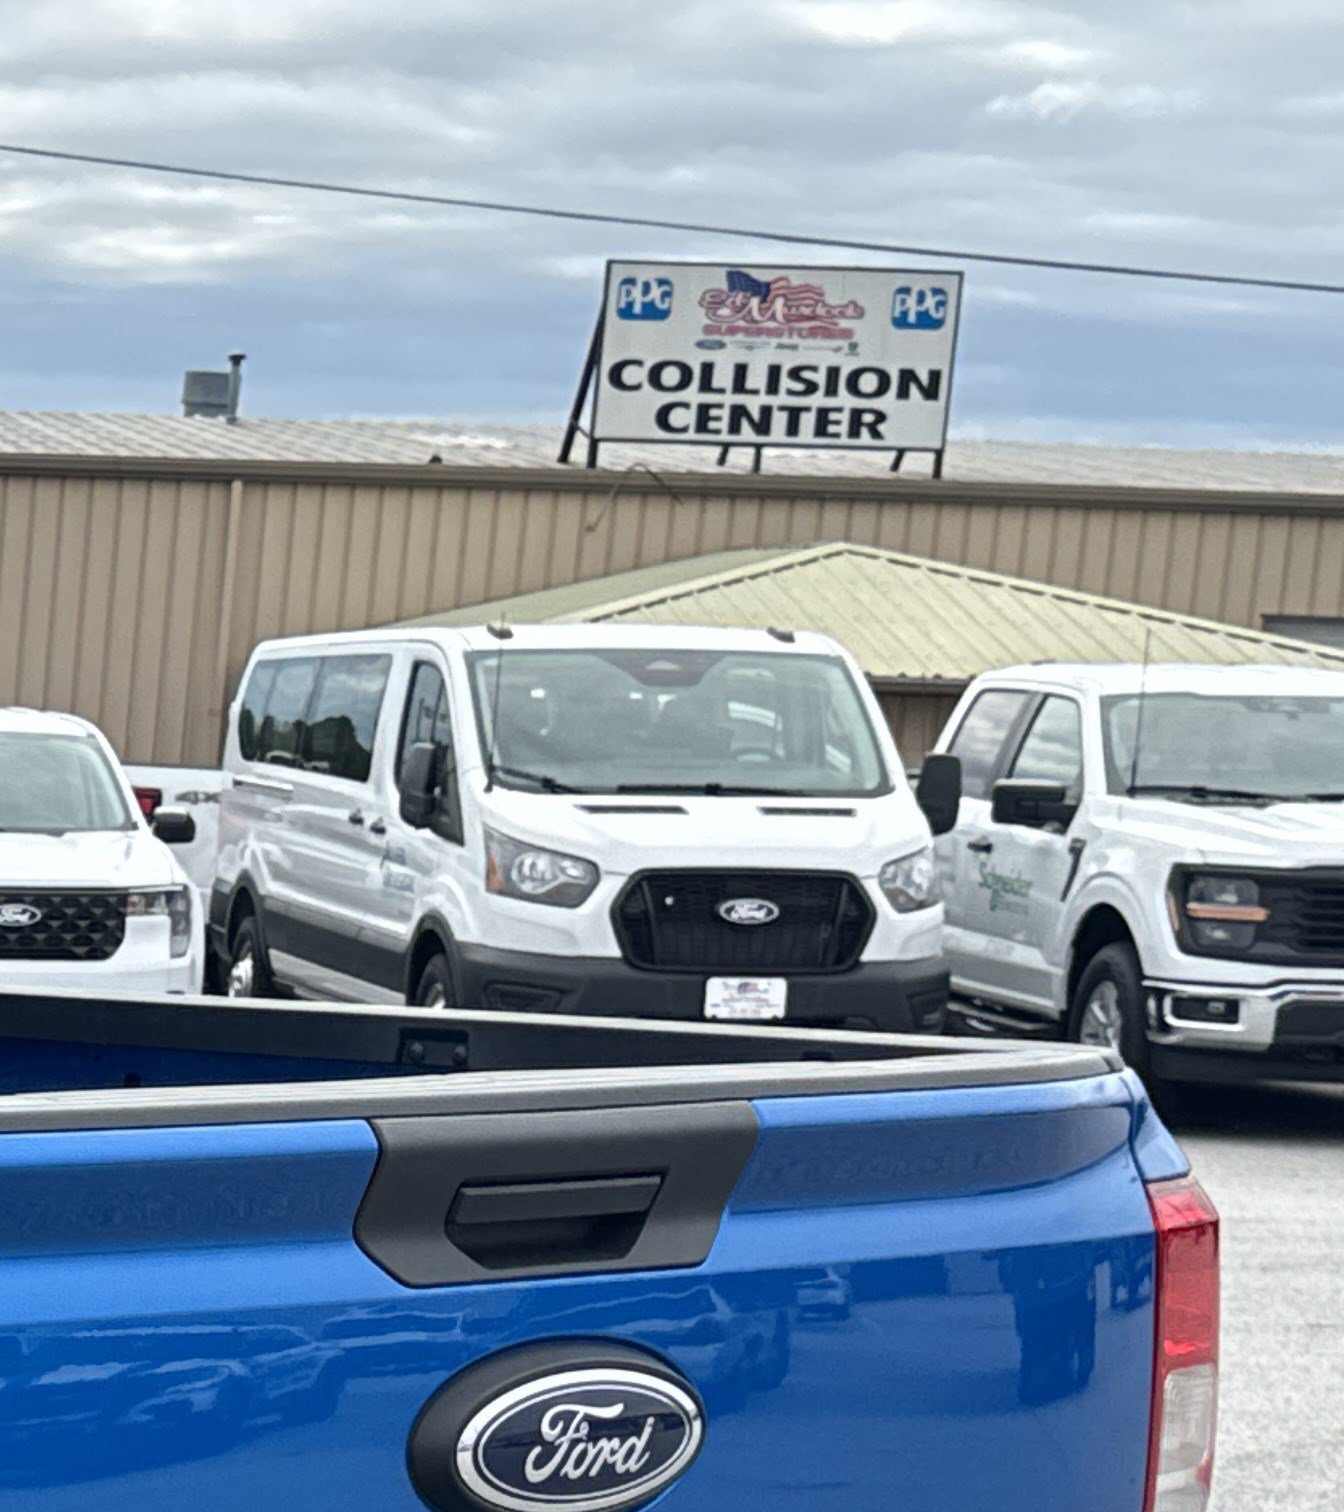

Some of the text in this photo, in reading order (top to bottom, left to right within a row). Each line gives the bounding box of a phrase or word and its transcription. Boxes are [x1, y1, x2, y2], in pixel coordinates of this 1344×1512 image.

[620, 278, 673, 315] PPG
[894, 287, 946, 324] PPG
[608, 358, 942, 401] COLLISION
[654, 401, 888, 440] CENTER
[524, 1402, 655, 1484] Ford
